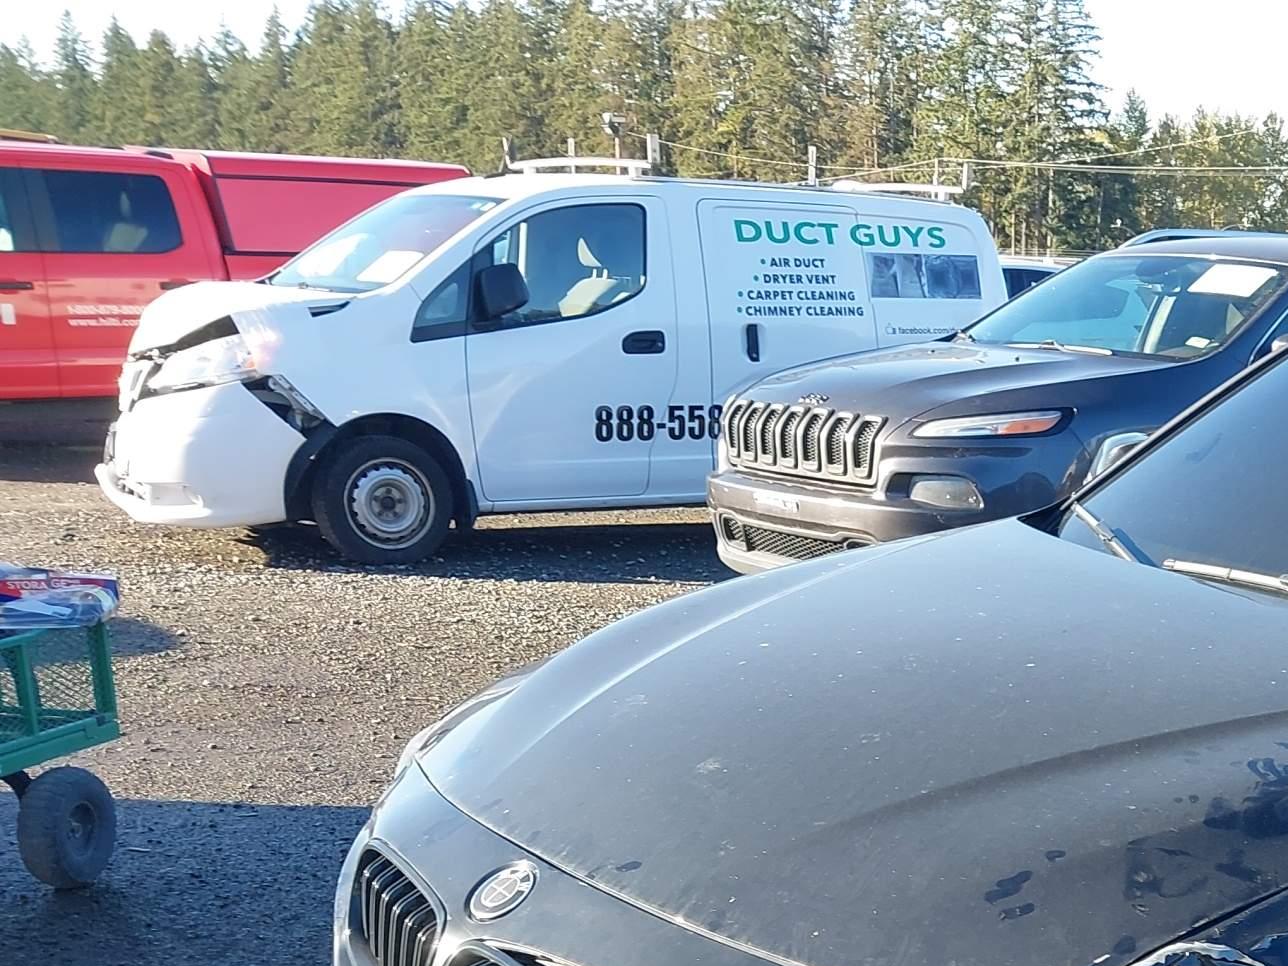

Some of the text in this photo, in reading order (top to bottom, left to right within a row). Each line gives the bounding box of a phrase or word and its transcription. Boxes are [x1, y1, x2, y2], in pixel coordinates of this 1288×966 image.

[734, 219, 946, 248] DUCT GUYS
[769, 257, 825, 268] AIR DUCT
[763, 274, 836, 284] DRYER VENT
[747, 290, 856, 301] CARPET CLEANING
[745, 306, 864, 316] CHIMNEY CLEANING
[595, 404, 723, 442] 888-558
